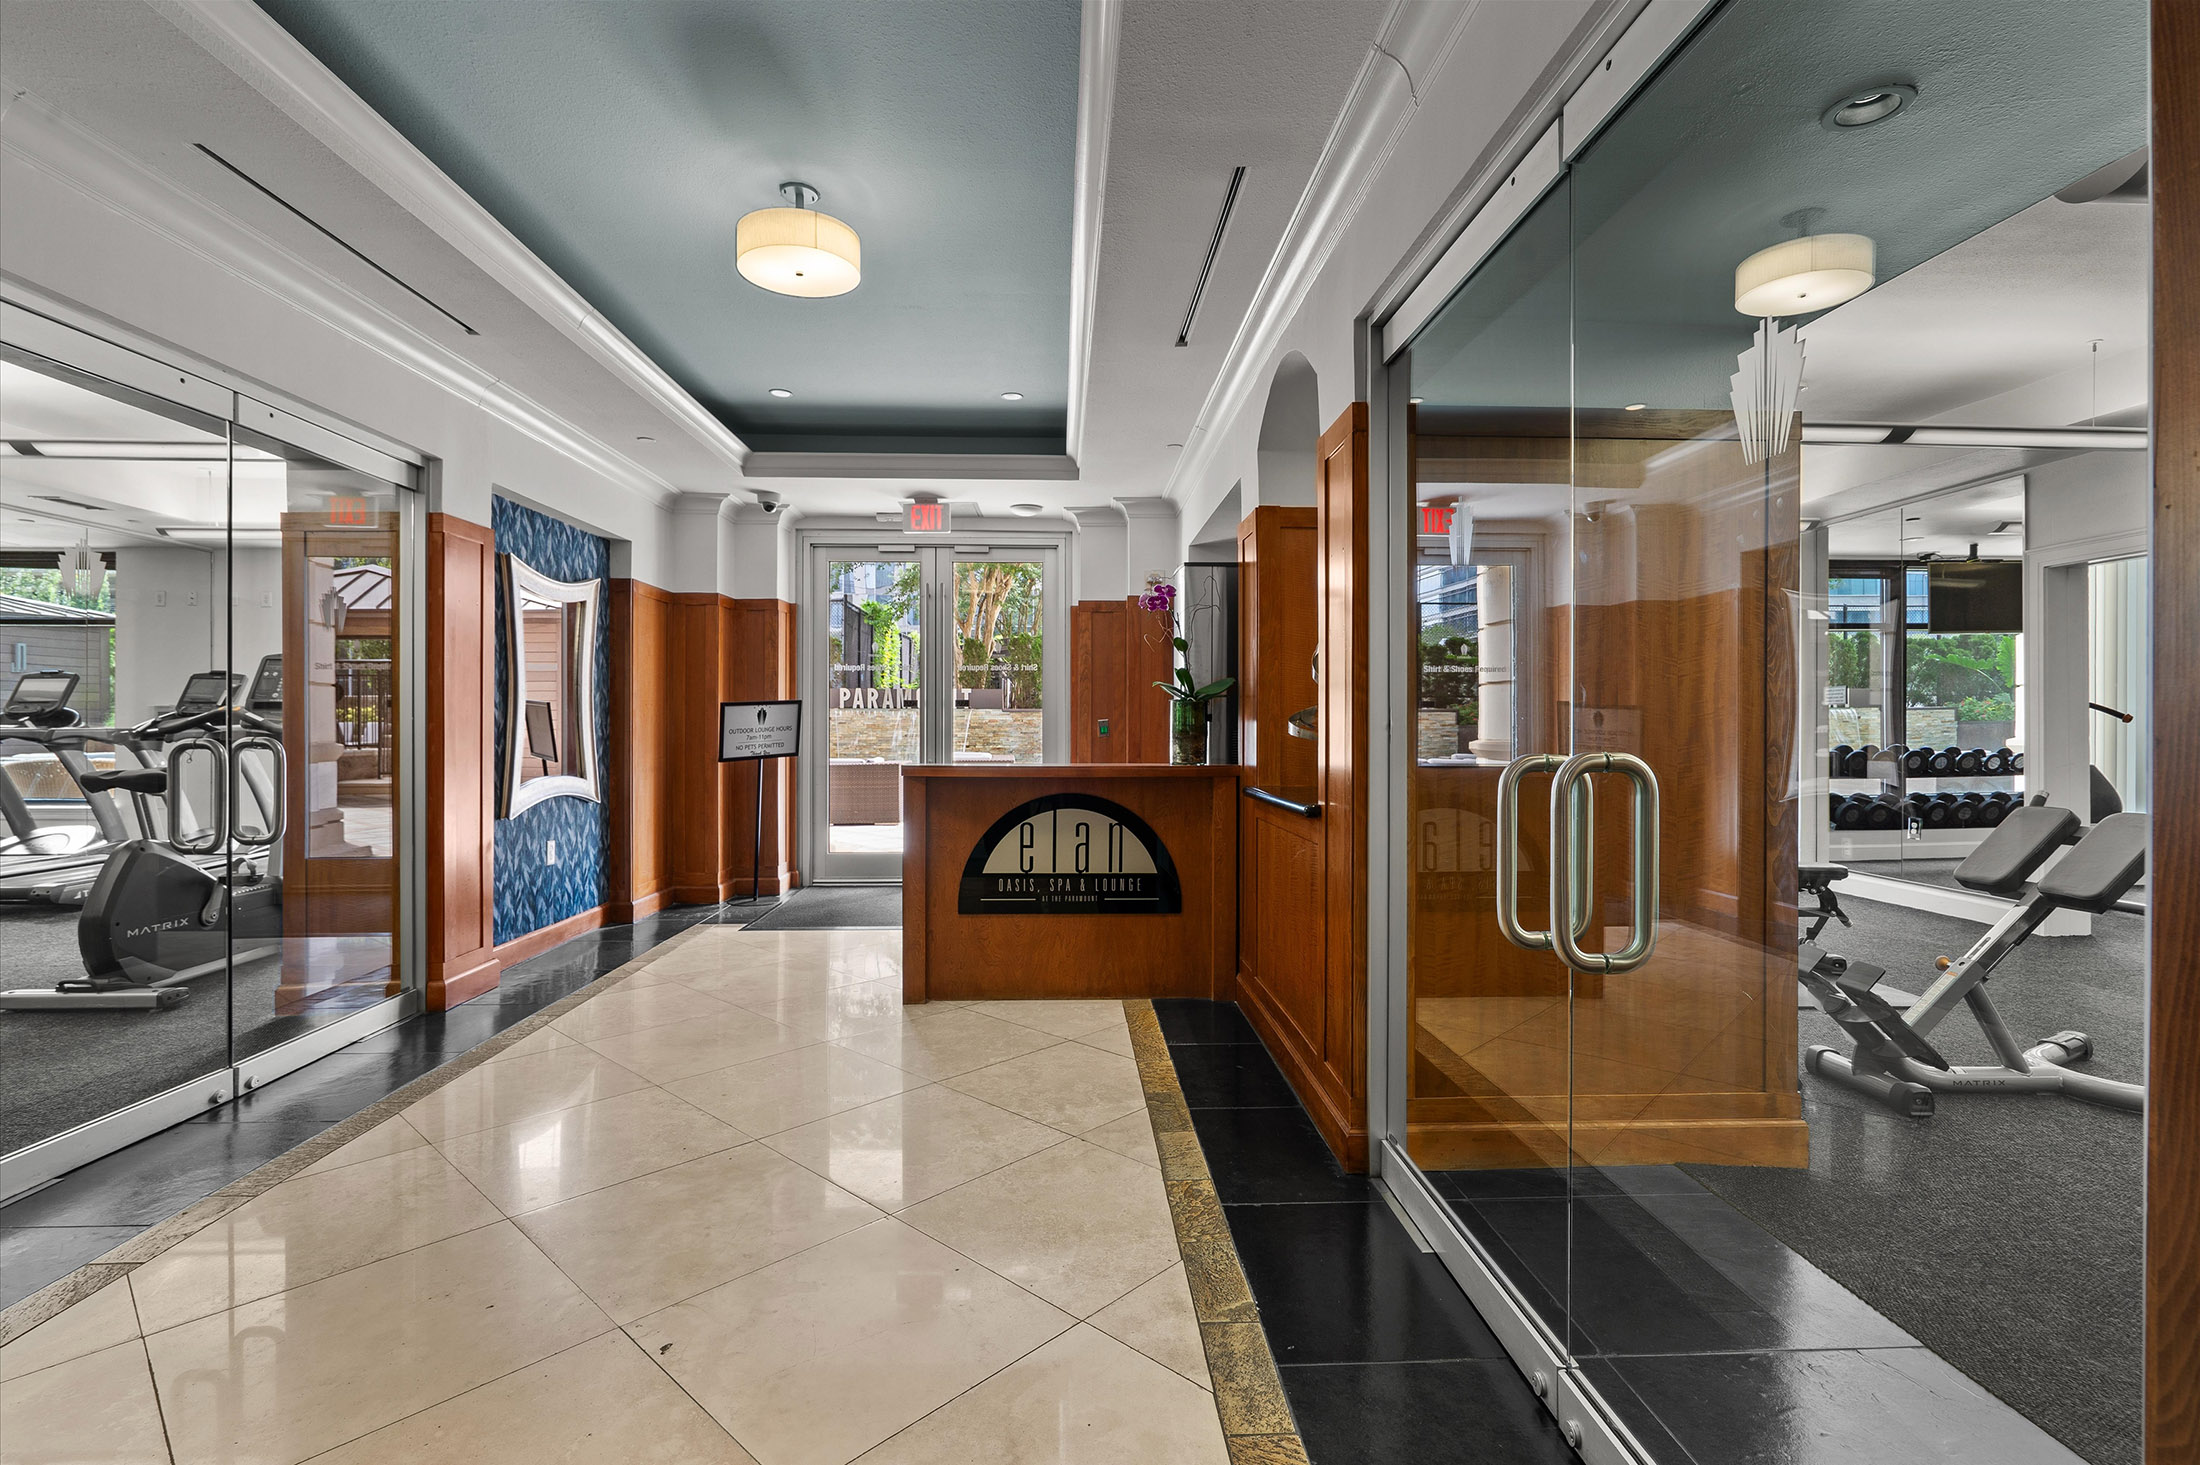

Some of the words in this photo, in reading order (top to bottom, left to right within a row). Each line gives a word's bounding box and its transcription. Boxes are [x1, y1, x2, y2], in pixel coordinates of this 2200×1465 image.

[911, 504, 944, 531] EXIT
[1423, 664, 1441, 673] Shirt
[1451, 665, 1473, 673] Shoes
[839, 687, 972, 709] PARAMT
[728, 727, 754, 735] OUTDOOR
[1020, 808, 1123, 874] elan
[998, 878, 1040, 893] OASIS,
[1050, 878, 1071, 892] SPA
[1080, 878, 1086, 892] &
[1095, 877, 1142, 892] LOUNGE
[127, 917, 189, 938] MATRIX
